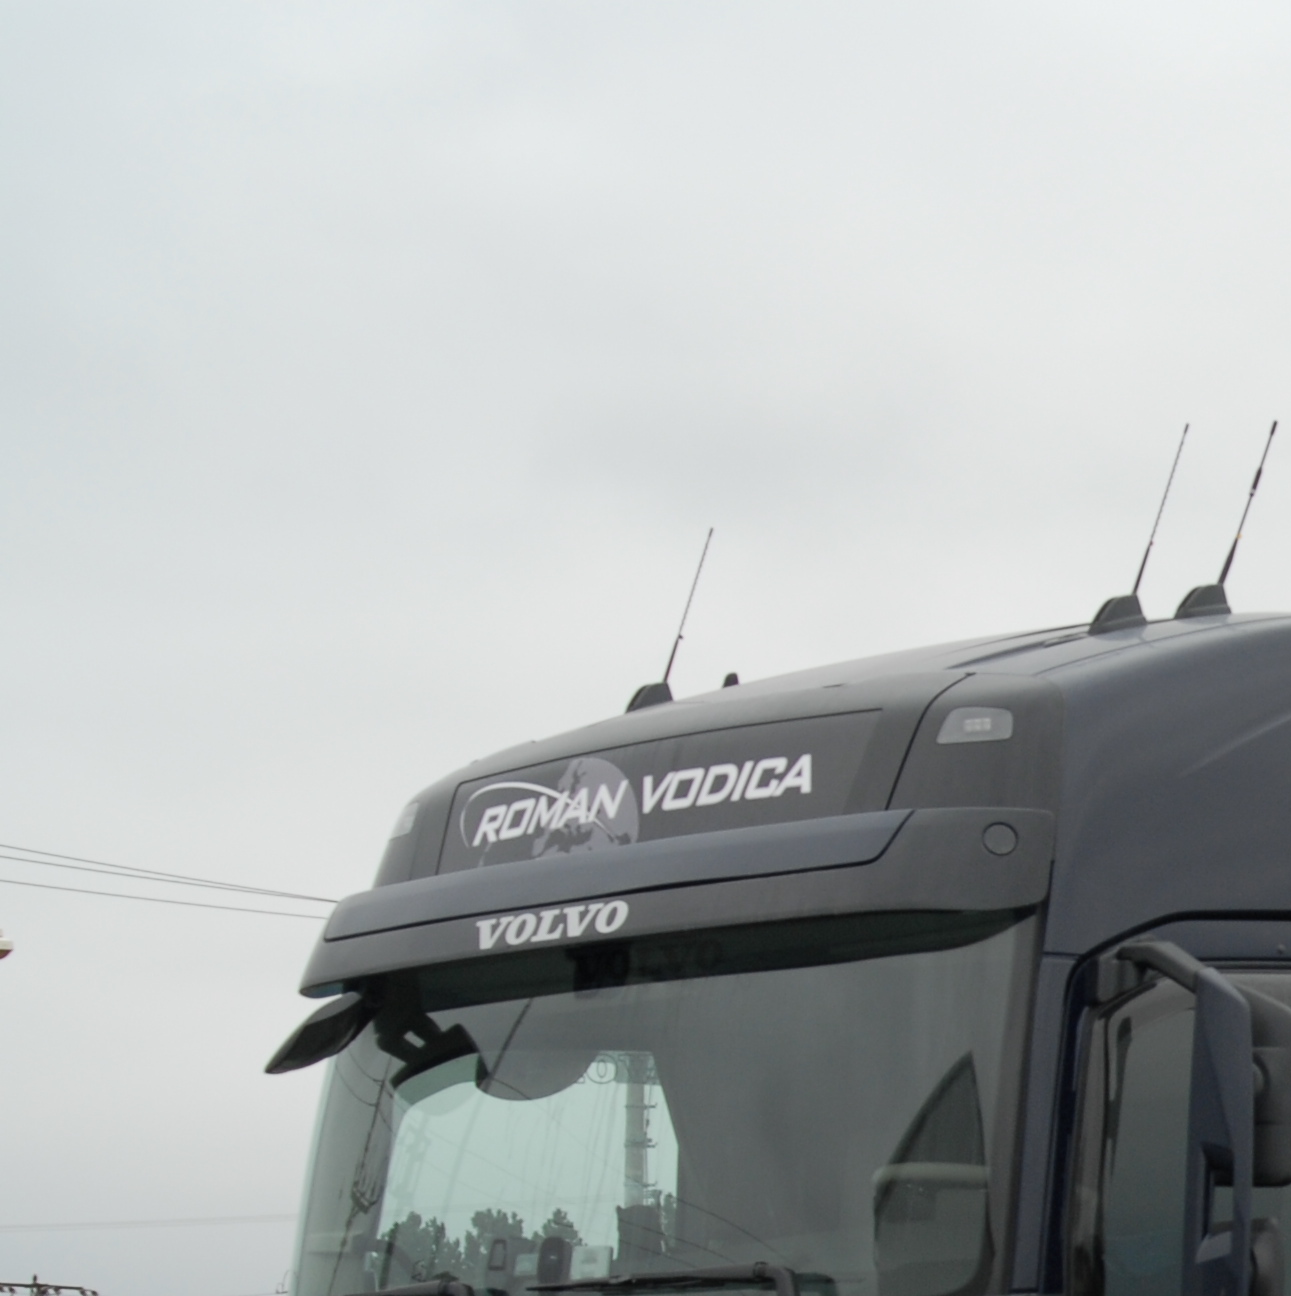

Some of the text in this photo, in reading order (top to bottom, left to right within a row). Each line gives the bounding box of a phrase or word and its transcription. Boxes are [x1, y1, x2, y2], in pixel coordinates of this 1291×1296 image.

[472, 754, 813, 848] ROMAN VODICA
[476, 900, 629, 950] VOLVO
